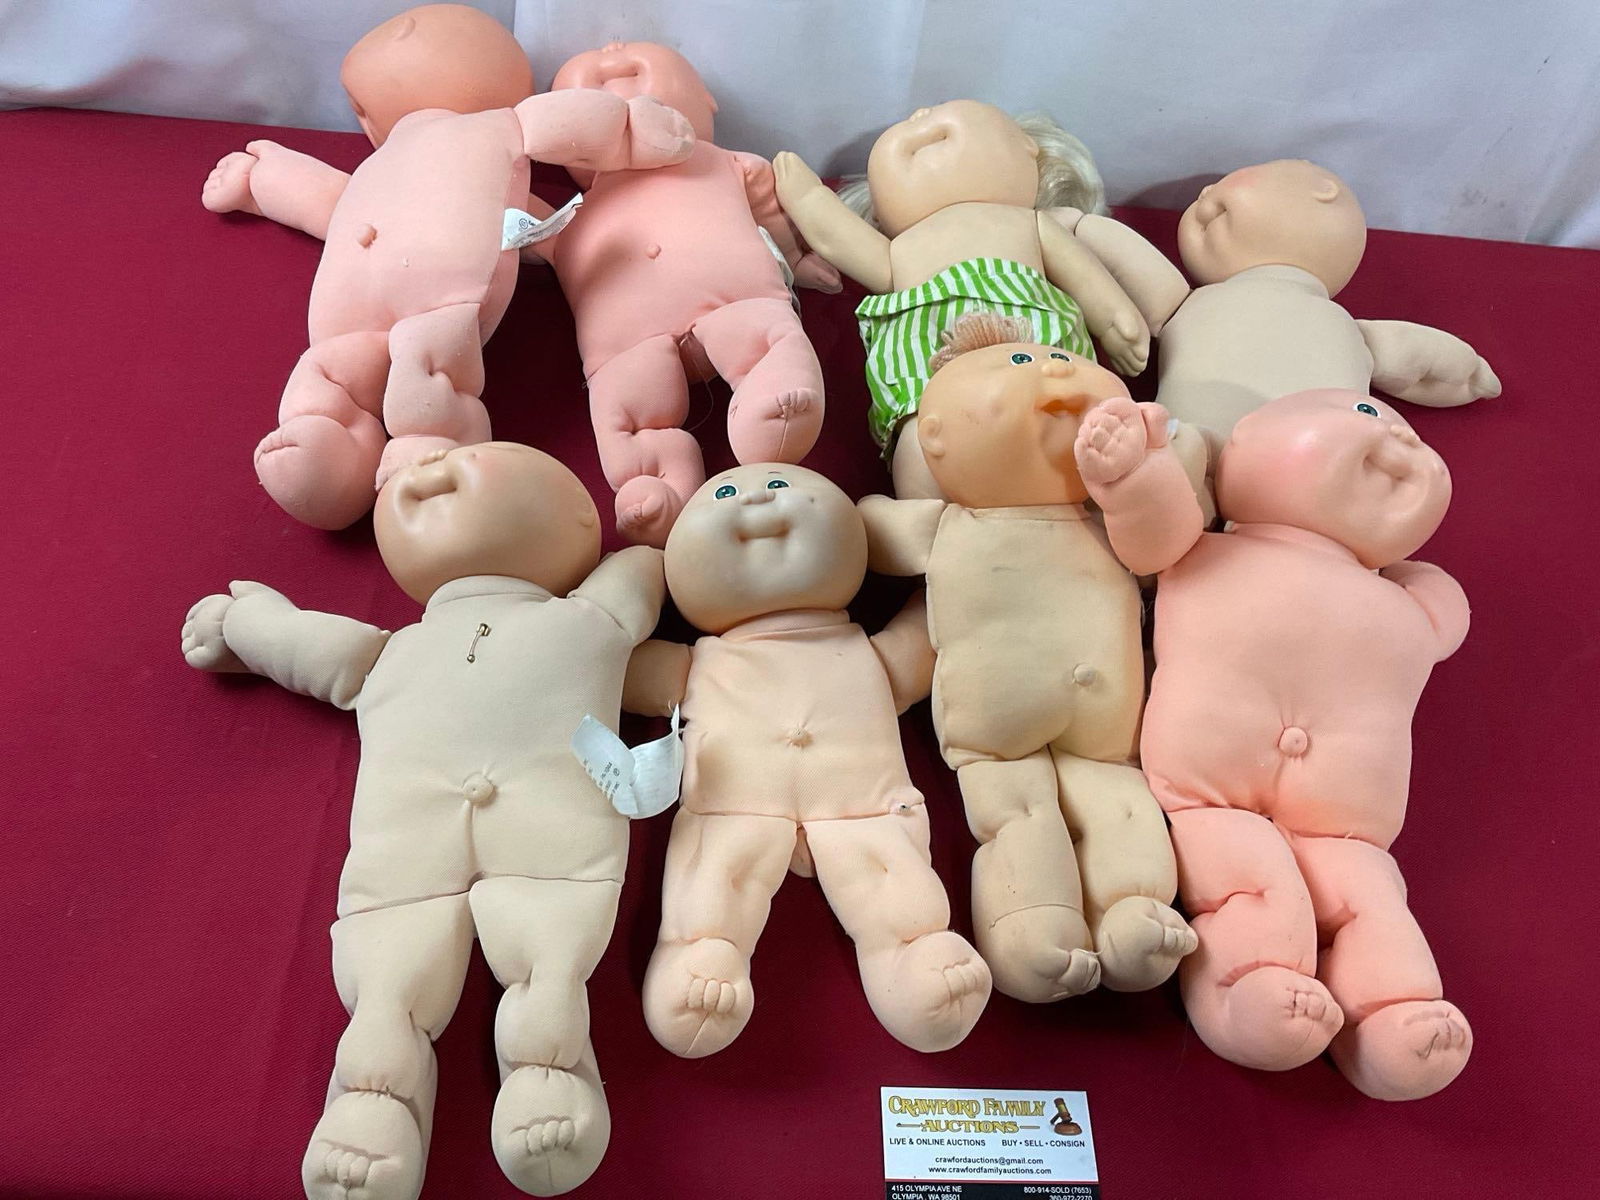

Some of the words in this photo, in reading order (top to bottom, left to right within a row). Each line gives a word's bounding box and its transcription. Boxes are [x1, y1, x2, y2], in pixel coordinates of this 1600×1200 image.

[888, 1095, 981, 1118] CRAWFORD
[983, 1097, 1046, 1117] FAMILY
[921, 1119, 1020, 1134] AUCTIONS
[889, 1138, 907, 1146] LIVE
[908, 1138, 914, 1146] &
[916, 1138, 945, 1146] ONLINE
[946, 1139, 986, 1147] AUCTIONS
[1001, 1139, 1018, 1147] BUY
[1049, 1140, 1085, 1148] CONSIGN
[935, 1156, 1043, 1165] crawfordauctions@gmail.com
[928, 1166, 1052, 1175] www.crawfordfamilyauctions.com
[1023, 1186, 1070, 1194] 800-914-SOLD
